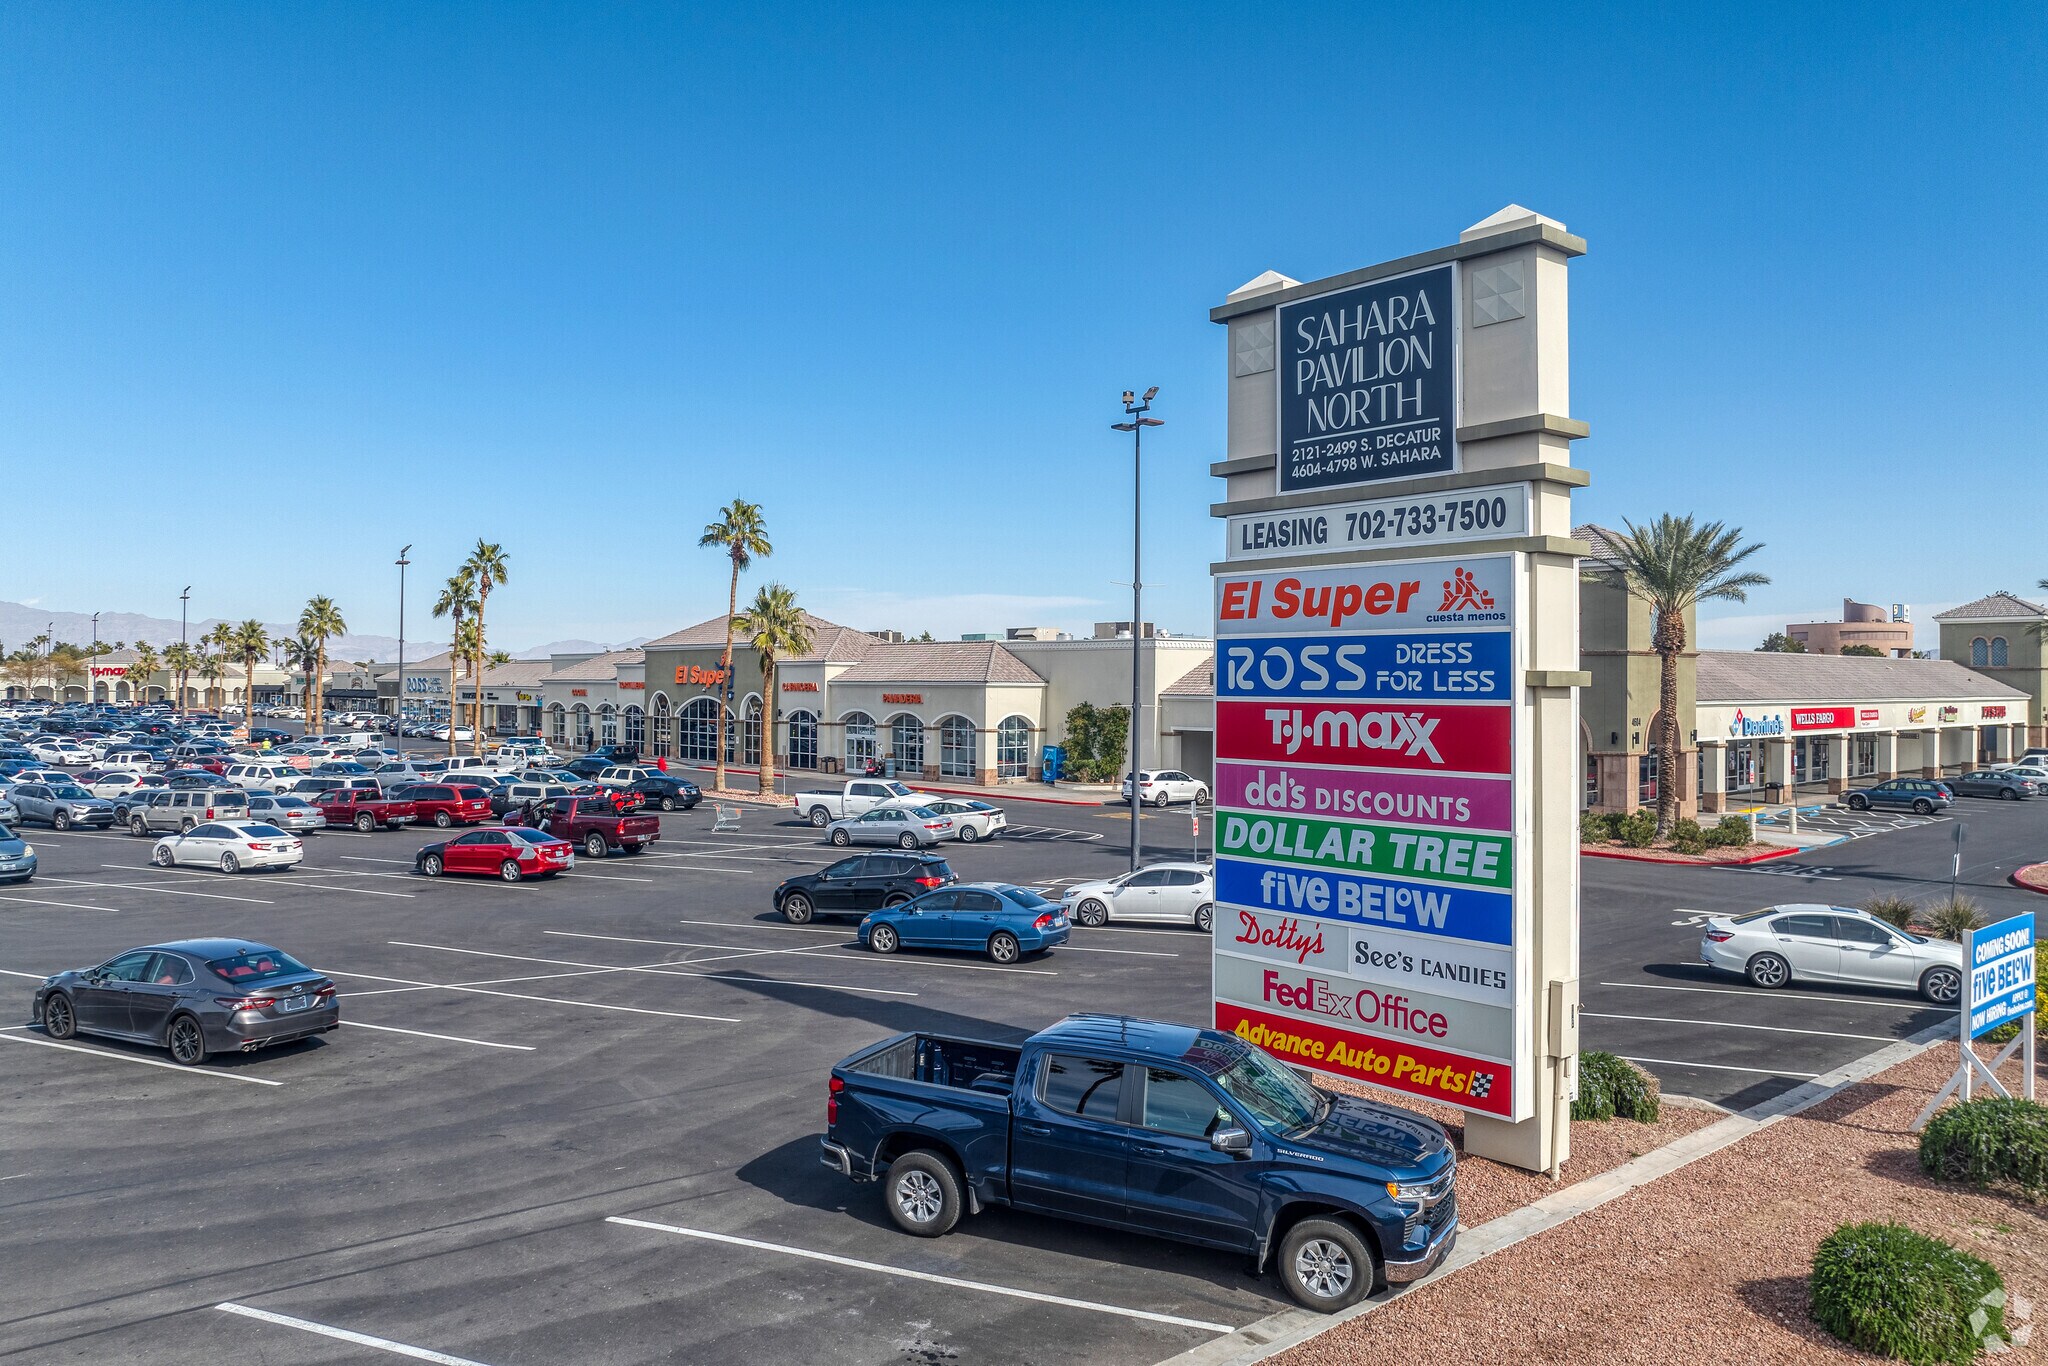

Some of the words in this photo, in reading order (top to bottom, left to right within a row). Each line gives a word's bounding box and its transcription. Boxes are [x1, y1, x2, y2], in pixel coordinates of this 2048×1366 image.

[1296, 289, 1436, 354] SAHARA
[1296, 331, 1433, 396] PAVILION
[1306, 378, 1423, 434] NORTH
[1291, 457, 1358, 478] 4604-4798
[1361, 455, 1377, 469] W.
[1381, 446, 1442, 466] SAHARA
[1292, 440, 1357, 462] 2121-2499
[1360, 437, 1373, 451] S.
[1376, 427, 1441, 448] DECATUR
[1242, 516, 1328, 551] LEASING
[1345, 497, 1507, 541] 702-733-7500
[1219, 580, 1263, 620] El
[1271, 577, 1420, 627] Super
[1426, 613, 1464, 623] cuesta
[1467, 611, 1506, 622] menos
[675, 665, 689, 684] El
[1227, 644, 1366, 691] ROSS
[1396, 642, 1473, 664] DRESS
[1376, 670, 1422, 692] FOR
[1433, 671, 1495, 692] LESS
[1742, 714, 1785, 737] Domino's
[1795, 712, 1815, 725] WELLS
[1815, 712, 1835, 724] FARGO
[1244, 769, 1306, 810] dd's
[1315, 787, 1471, 822] DISCOUNTS
[1223, 816, 1376, 866] DOLLAR
[1388, 833, 1503, 880] TREE
[1260, 870, 1330, 912] five
[1337, 880, 1451, 929] BELOW
[1235, 910, 1325, 965] Dotty's
[1975, 936, 2005, 965] COMING
[2004, 927, 2030, 952] SOON!
[1355, 940, 1414, 973] See's
[1421, 959, 1507, 990] CANDIES
[1973, 967, 1996, 1003] five
[1997, 953, 2032, 992] BELOW
[1262, 968, 1353, 1020] FedEx
[1355, 989, 1449, 1038] Office
[1972, 1010, 1985, 1031] NOW
[1986, 1001, 2007, 1023] HIRING
[1234, 1018, 1325, 1060] Advance
[1325, 1041, 1389, 1075] Auto
[1391, 1055, 1466, 1094] Parts
[1276, 1148, 1324, 1162] SILVERADO
